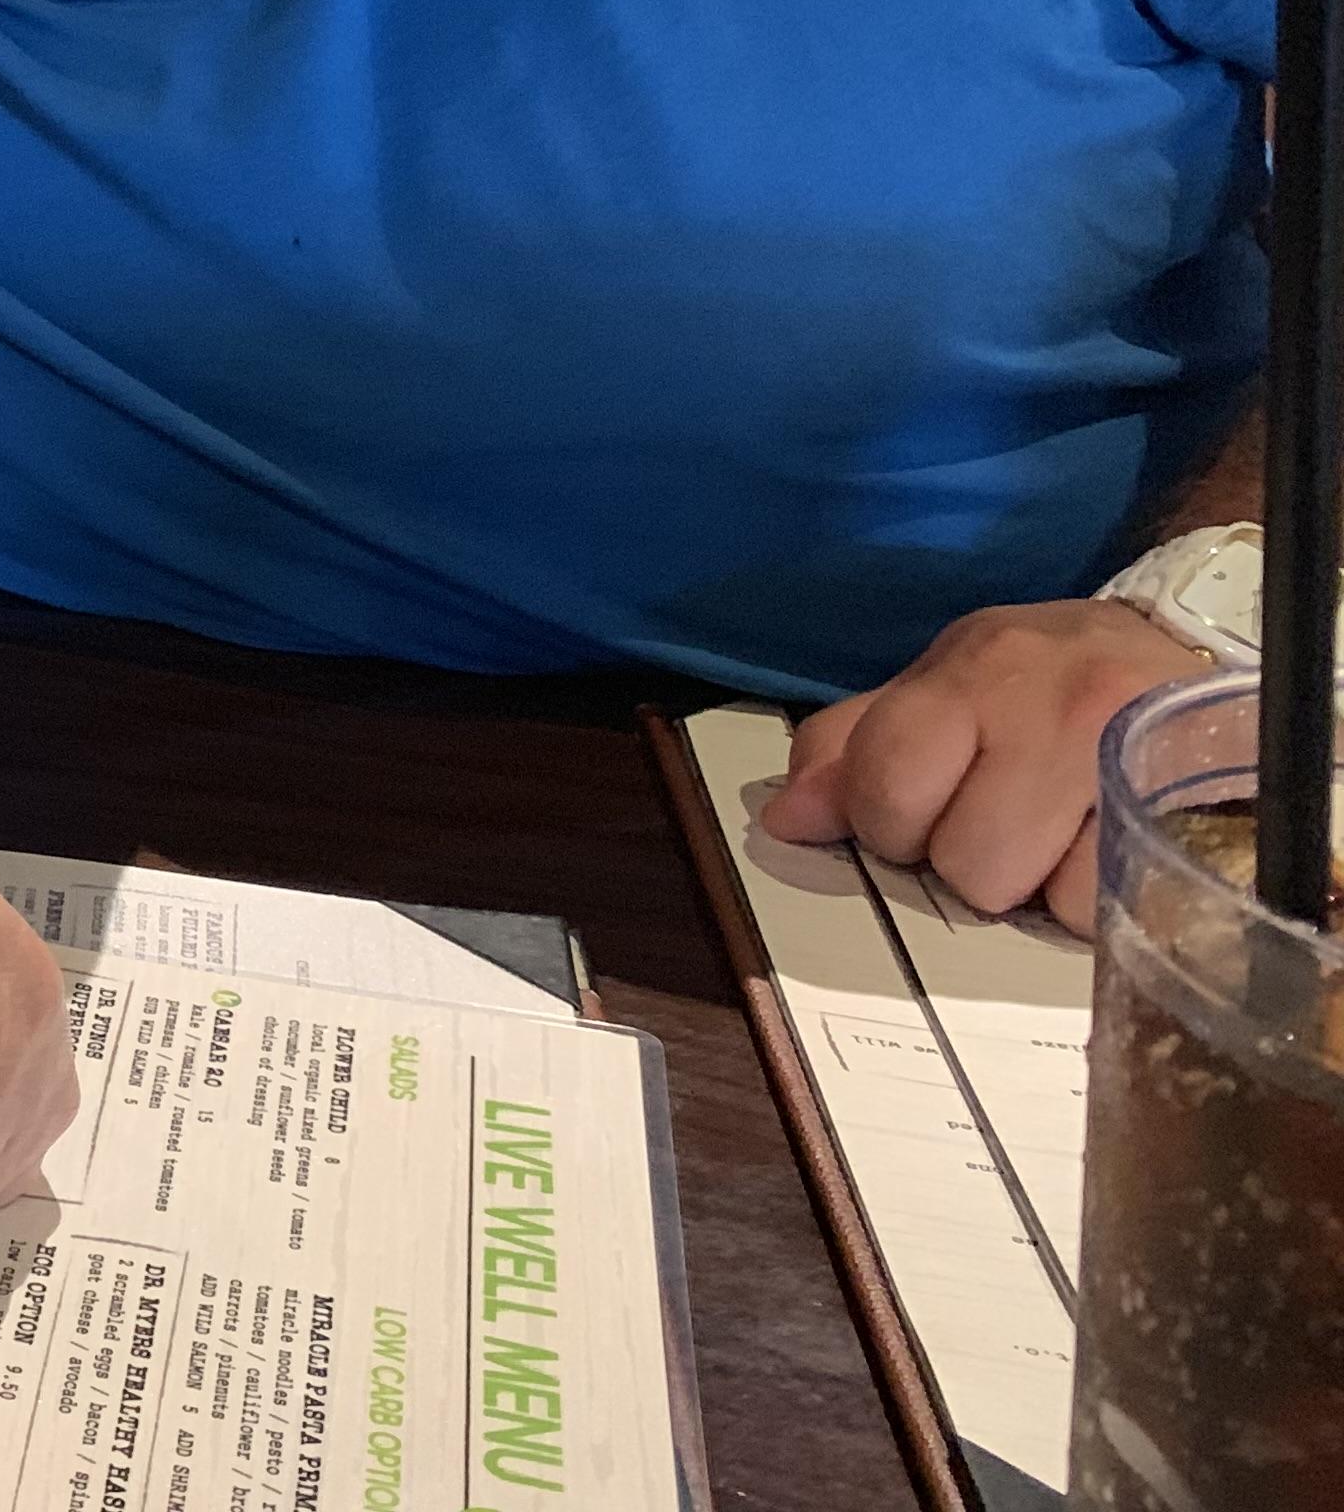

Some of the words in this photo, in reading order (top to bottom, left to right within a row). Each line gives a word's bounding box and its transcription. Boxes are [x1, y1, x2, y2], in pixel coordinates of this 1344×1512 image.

[84, 1013, 112, 1060] FUNGS
[188, 1003, 207, 1029] kale
[208, 1008, 234, 1063] CAESAR
[260, 1015, 279, 1052] choice
[309, 1022, 328, 1053] local
[177, 1044, 197, 1088] romaine
[257, 1056, 274, 1071] of
[283, 1019, 301, 1068] cucumber
[332, 1026, 355, 1084] FLOWER
[849, 1034, 902, 1050] will
[302, 1057, 321, 1103] organic
[387, 1034, 420, 1102] SALADS
[196, 1109, 214, 1123] 15
[245, 1074, 272, 1127] dressing
[273, 1084, 294, 1143] sunflower
[300, 1106, 318, 1142] mixed
[327, 1087, 350, 1134] CHILD
[165, 1105, 186, 1153] roasted
[483, 1099, 554, 1195] LIVE
[154, 1157, 178, 1212] tomatoes
[268, 1148, 286, 1183] seeds
[293, 1145, 311, 1187] greens
[323, 1156, 340, 1165] 8
[6, 1238, 27, 1262] low
[287, 1207, 307, 1250] tomato
[85, 1252, 105, 1283] goat
[117, 1258, 134, 1267] 2
[199, 1272, 218, 1298] ADD
[482, 1203, 557, 1326] WELL
[12, 1281, 47, 1345] OPTION
[75, 1289, 100, 1335] cheese
[102, 1272, 129, 1342] scrambled
[129, 1295, 160, 1359] MYERS
[193, 1302, 214, 1335] WILD
[222, 1278, 243, 1332] carrots
[279, 1287, 301, 1343] miracle
[306, 1293, 334, 1378] MIRACLE
[372, 1305, 407, 1363] LOW
[57, 1356, 83, 1415] avocado
[91, 1346, 114, 1379] eggs
[185, 1340, 208, 1390] SALMON
[209, 1352, 236, 1420] pinenuts
[272, 1349, 294, 1407] noodles
[110, 1363, 148, 1459] HEALTHY
[181, 1404, 199, 1414] 5
[299, 1381, 327, 1446] PASTA
[367, 1364, 405, 1427] CARB
[482, 1335, 564, 1492] MENU
[81, 1401, 107, 1446] bacon
[174, 1428, 194, 1458] ADD
[263, 1428, 284, 1476] pesto
[294, 1452, 322, 1512] PRIM
